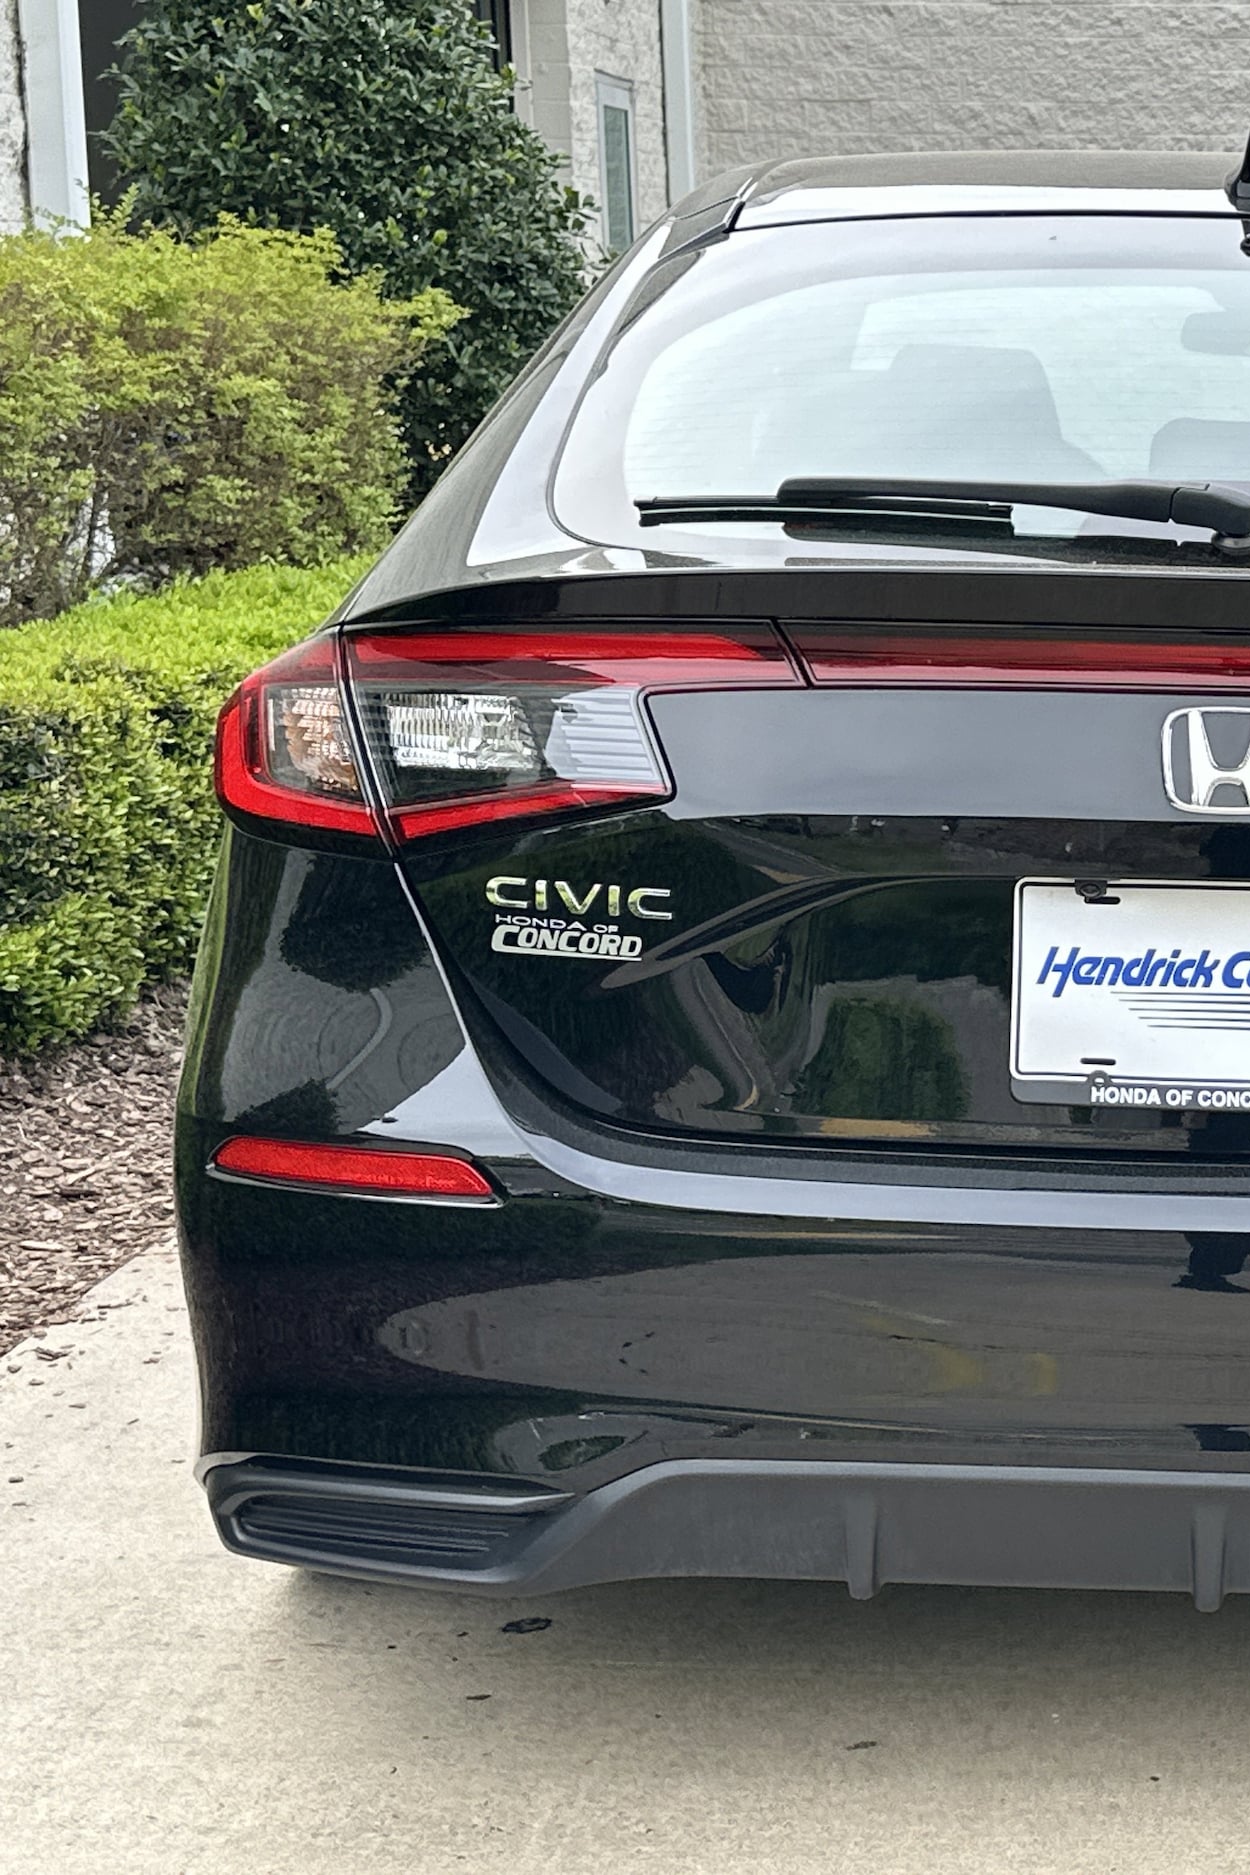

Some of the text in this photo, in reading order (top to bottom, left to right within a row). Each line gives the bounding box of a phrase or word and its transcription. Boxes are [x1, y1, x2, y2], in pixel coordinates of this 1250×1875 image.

[486, 876, 672, 920] CIVIC
[495, 914, 619, 933] HONDA OF
[491, 924, 642, 958] CONCORD
[1091, 1086, 1160, 1105] HONDA
[1166, 1089, 1193, 1106] OF
